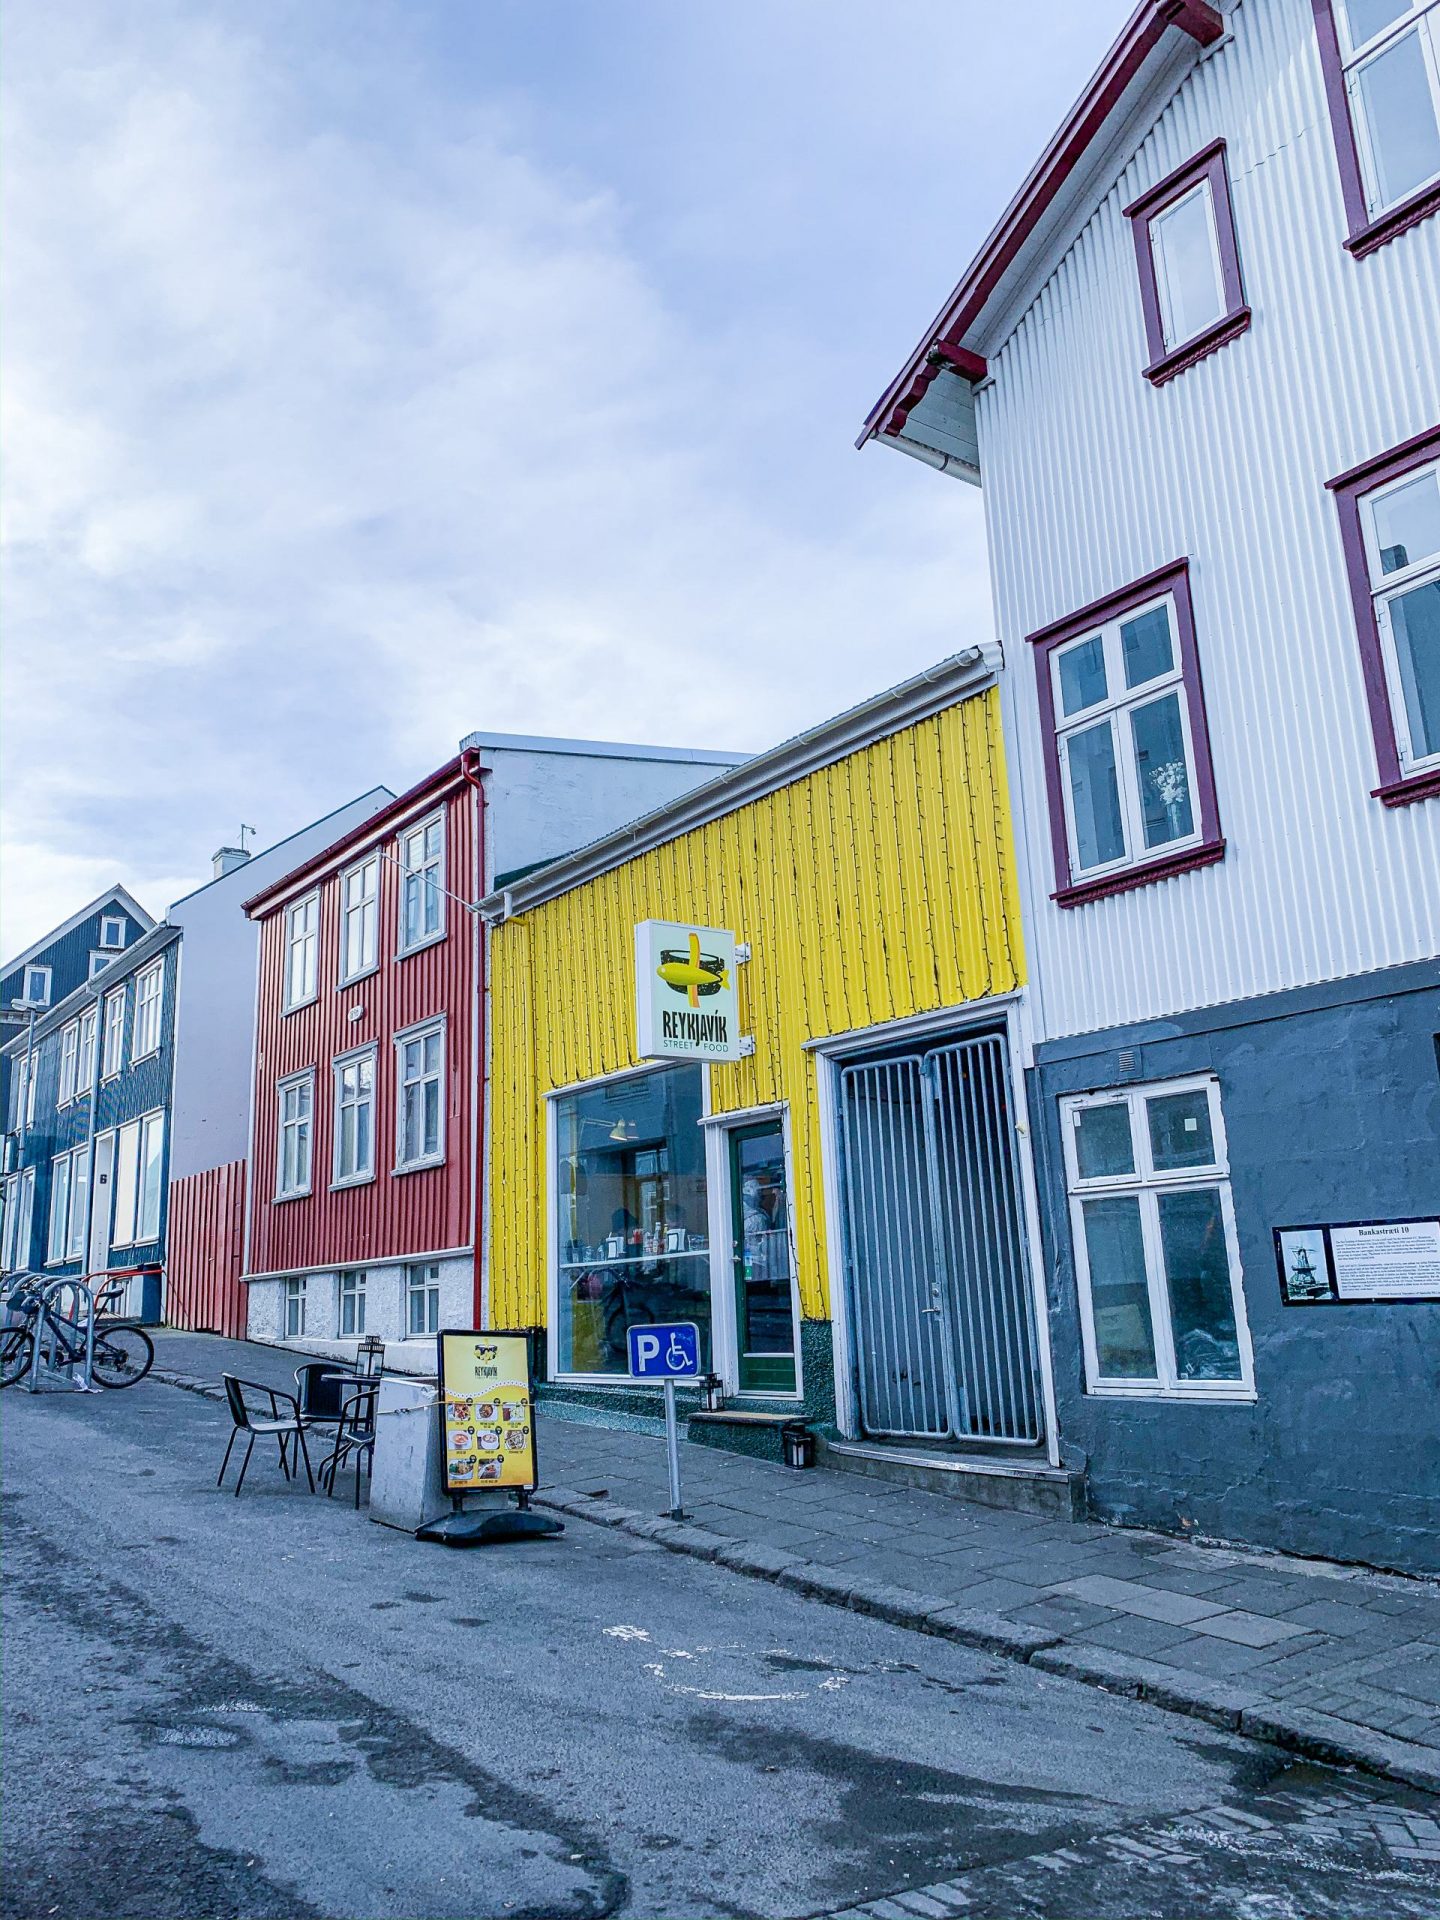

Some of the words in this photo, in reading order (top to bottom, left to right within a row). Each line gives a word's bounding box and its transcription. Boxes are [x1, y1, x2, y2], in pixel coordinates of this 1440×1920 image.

[662, 1009, 728, 1046] REYKJAVÍK
[663, 1039, 694, 1051] STREET
[703, 1042, 729, 1053] FOOD
[100, 1174, 107, 1184] 6
[1401, 1226, 1410, 1234] 10
[637, 1334, 660, 1372] P
